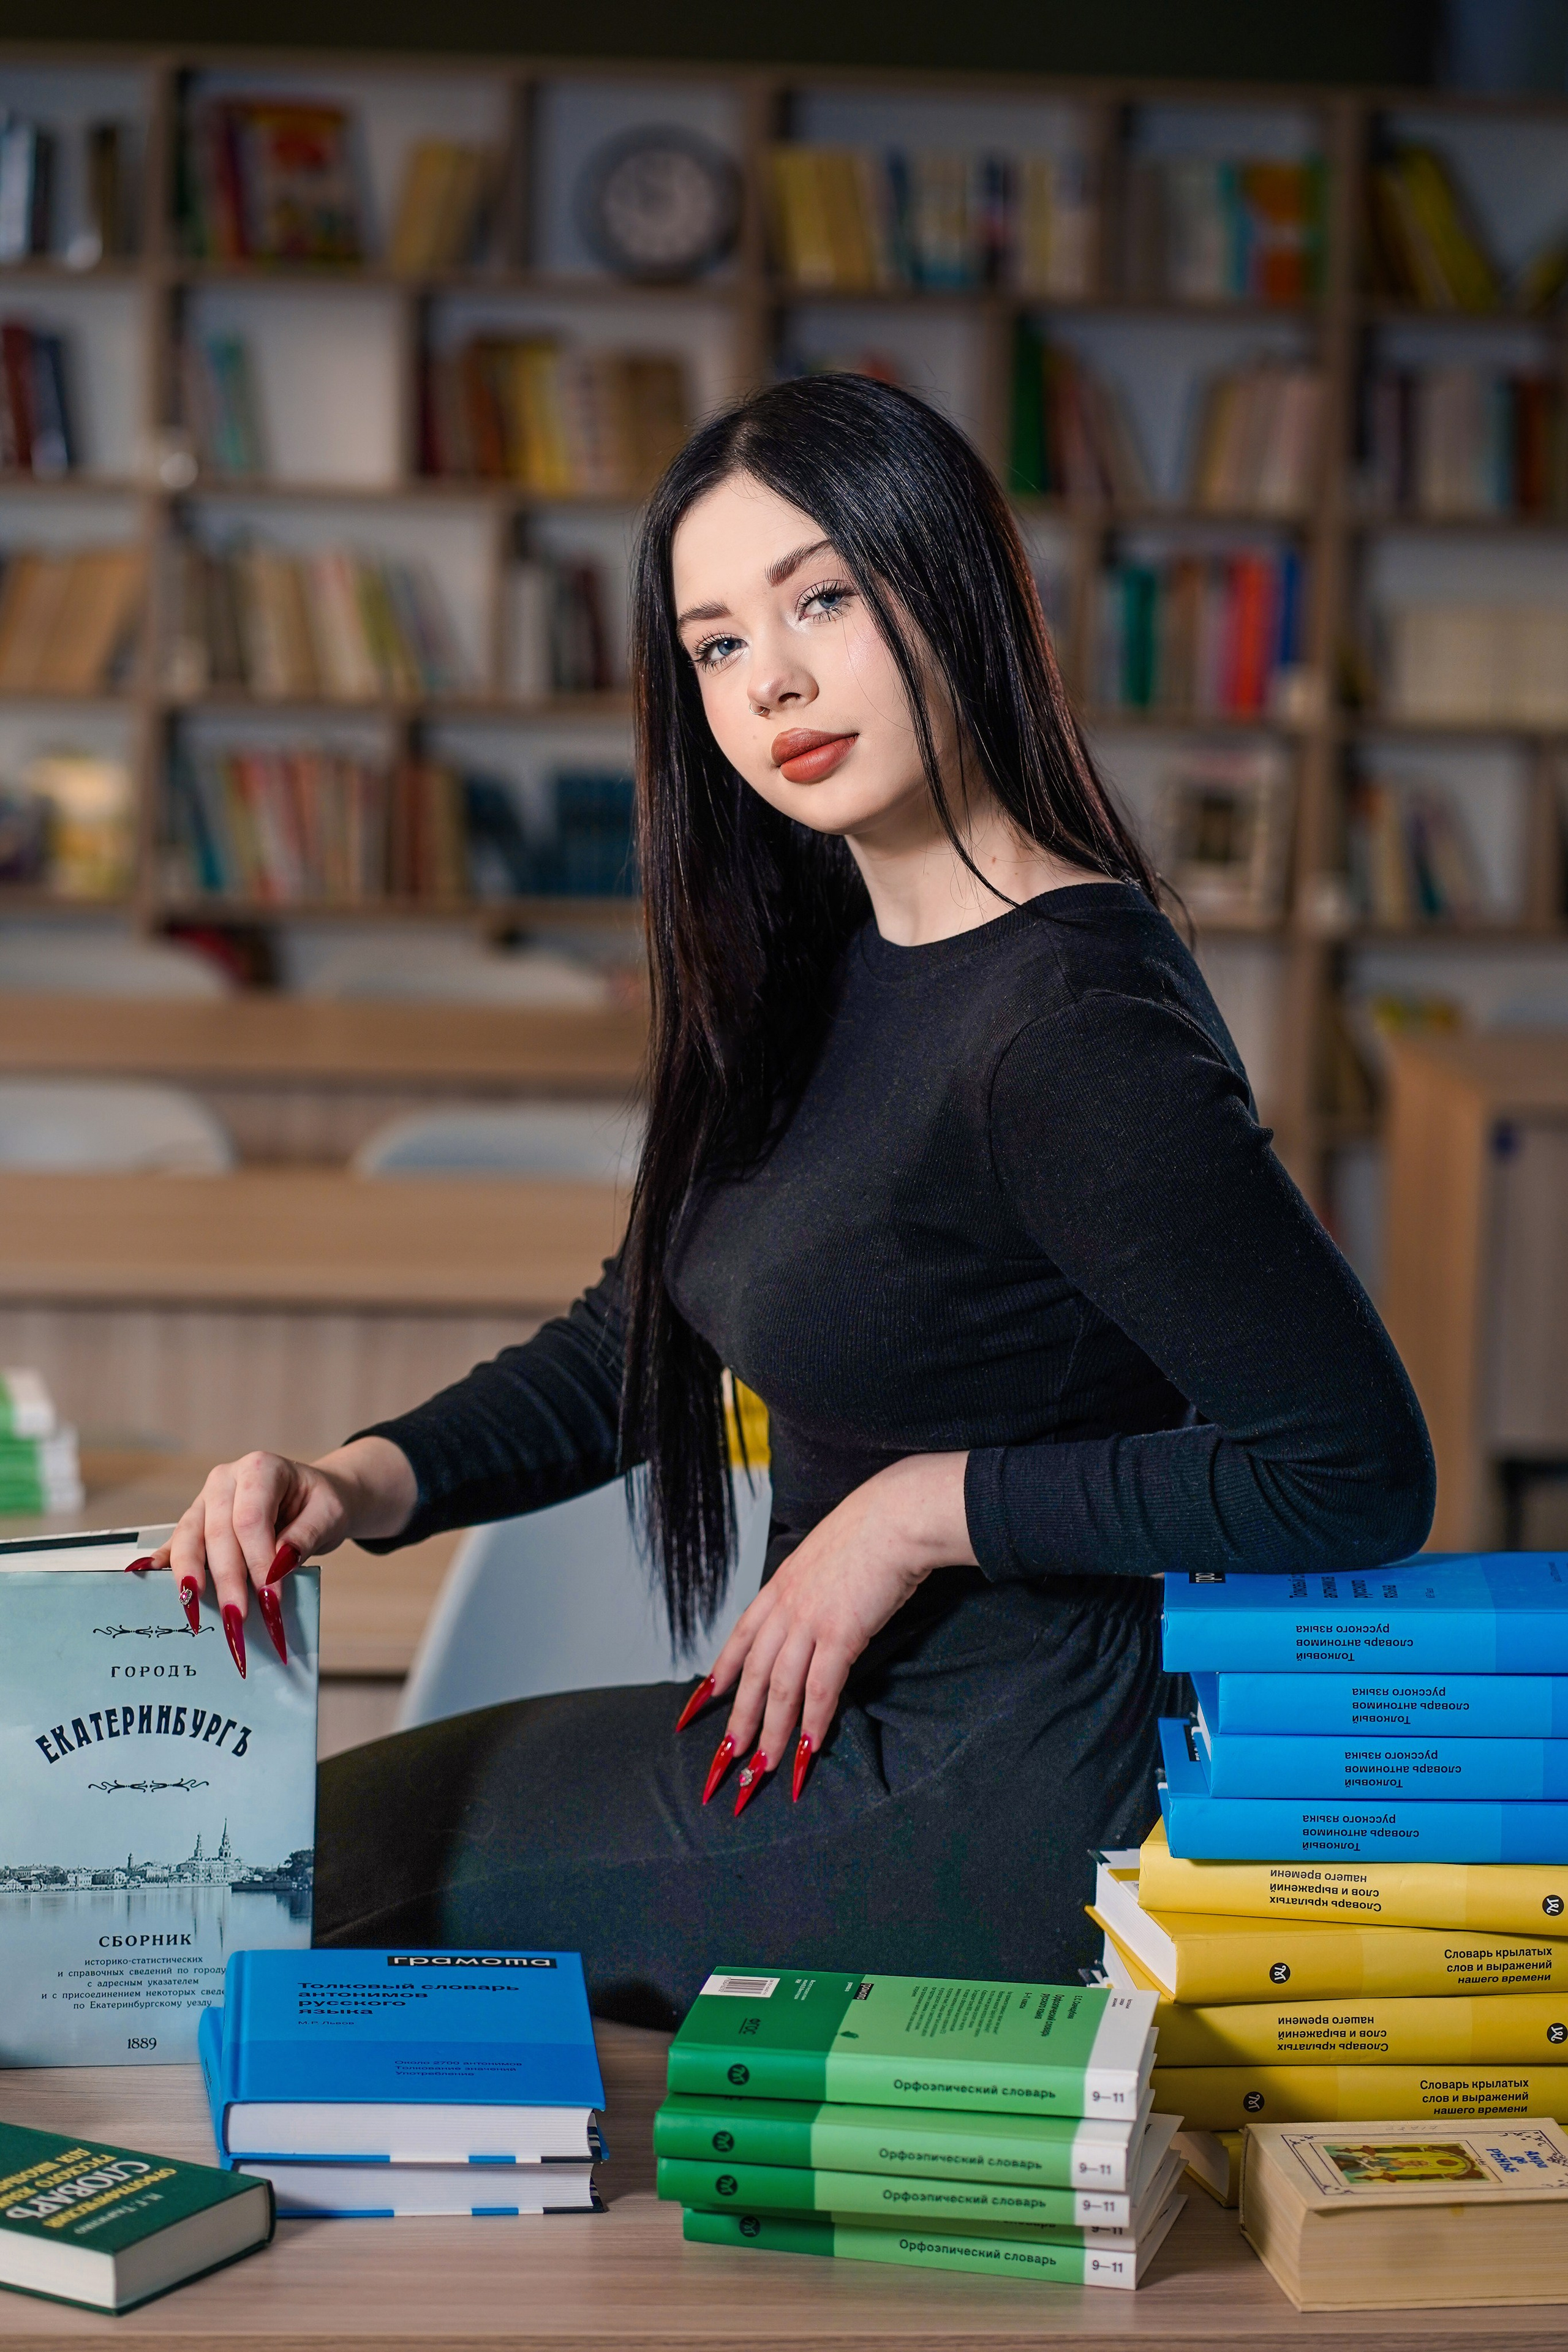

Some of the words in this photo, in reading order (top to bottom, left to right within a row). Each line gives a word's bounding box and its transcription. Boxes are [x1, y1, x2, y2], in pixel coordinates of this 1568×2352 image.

[1296, 1624, 1332, 1633] языка
[1336, 1624, 1390, 1634] русского
[1296, 1638, 1361, 1646] антонимов
[1364, 1639, 1414, 1648] словарь
[1296, 1651, 1354, 1662] Толковый
[111, 1665, 197, 1678] ГОРОДЪ
[1393, 1687, 1446, 1697] русского
[1352, 1715, 1411, 1724] Толковый
[35, 1705, 252, 1764] ЕКАТЕРИНБУРГЪ
[1344, 1751, 1381, 1760] языка
[1384, 1751, 1438, 1760] русского
[1344, 1765, 1409, 1773] антонимов
[1344, 1778, 1403, 1788] Толковый
[1342, 1814, 1396, 1824] русского
[1303, 1828, 1368, 1837] антонимов
[1302, 1841, 1361, 1851] Толковый
[1270, 1869, 1321, 1880] времени
[1324, 1874, 1366, 1883] нашего
[1270, 1883, 1339, 1894] выражений
[1351, 1888, 1379, 1897] слов
[1270, 1896, 1328, 1907] крылатых
[1332, 1901, 1381, 1912] Словарь
[99, 1934, 192, 1947] СБОРНИК
[1444, 1949, 1493, 1959] Словарь
[1496, 1946, 1553, 1959] крылатых
[85, 1956, 203, 1966] историко-статистических
[393, 1957, 551, 1966] грамота
[1447, 1963, 1474, 1973] слов
[1486, 1960, 1552, 1972] выражений
[69, 1969, 124, 1978] справочных
[194, 1966, 226, 1975] городу
[97, 1979, 143, 1988] адресным
[148, 1978, 198, 1986] указателем
[1458, 1975, 1499, 1985] нашего
[1501, 1973, 1551, 1983] времени
[62, 1990, 140, 1999] присоединением
[90, 2000, 181, 2009] Екатеринбургскому
[1278, 2016, 1329, 2026] времени
[1278, 2029, 1347, 2040] выражений
[127, 2037, 157, 2049] 1889
[1277, 2043, 1336, 2051] крылатых
[1338, 2043, 1388, 2052] Словарь
[894, 2079, 998, 2095] Орфоэпический
[1002, 2087, 1056, 2099] словарь
[1420, 2080, 1469, 2090] Словарь
[1472, 2078, 1529, 2090] крылатых
[1092, 2090, 1124, 2102] 9—11
[1422, 2094, 1450, 2103] слов
[1462, 2091, 1529, 2103] выражений
[1433, 2106, 1475, 2115] нашего
[1478, 2105, 1528, 2114] времени
[880, 2148, 984, 2165] Орфоэпический
[988, 2158, 1042, 2170] словарь
[1079, 2163, 1111, 2174] 9—11
[6, 2161, 150, 2218] СЛОВАРЬ
[883, 2190, 988, 2207] Орфоэпический
[992, 2197, 1047, 2209] словарь
[1083, 2201, 1115, 2211] 9—11
[900, 2239, 1000, 2260] Орфоэпический
[1005, 2253, 1057, 2266] словарь
[1092, 2260, 1123, 2273] 9—11
